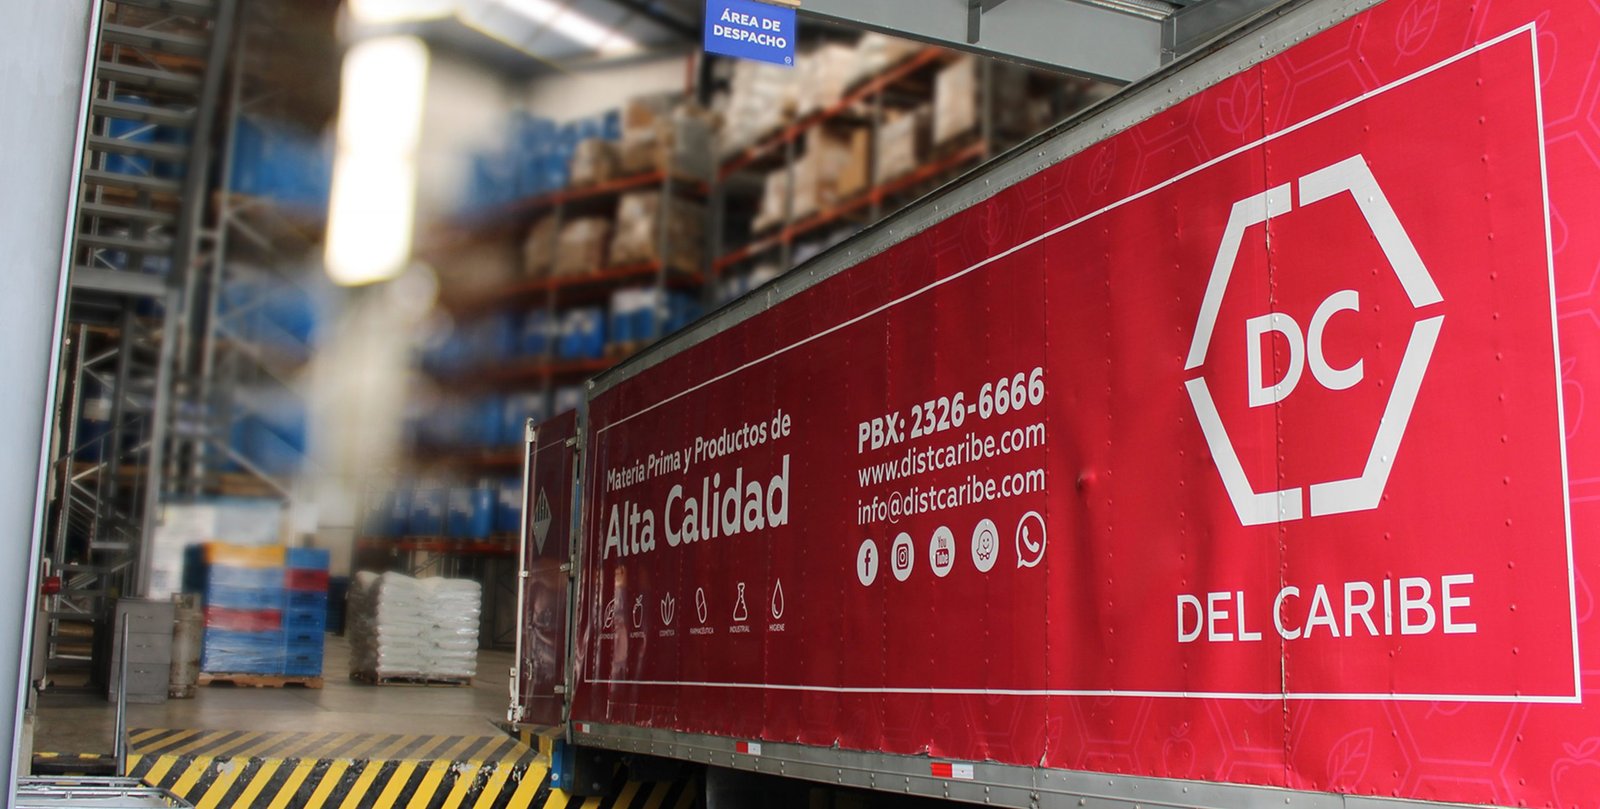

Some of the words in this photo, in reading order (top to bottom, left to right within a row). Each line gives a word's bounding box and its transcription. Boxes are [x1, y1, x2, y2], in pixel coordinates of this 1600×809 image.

[713, 24, 787, 49] DESPACHO
[720, 7, 759, 28] ÁREA
[762, 18, 781, 32] DE
[1246, 289, 1364, 408] DC
[857, 411, 905, 454] PBX:
[910, 367, 1045, 439] 2326-6666
[606, 459, 645, 493] Materia
[647, 449, 681, 478] Prima
[683, 447, 692, 475] y
[694, 420, 767, 464] Productos
[771, 408, 792, 440] de
[857, 422, 1046, 488] www.distcaribe.com
[603, 500, 656, 560] Alta
[664, 453, 790, 547] Calidad
[857, 468, 1046, 525] info@distcaribe.com
[1176, 591, 1262, 643] DEL
[1272, 573, 1478, 640] CARIBE
